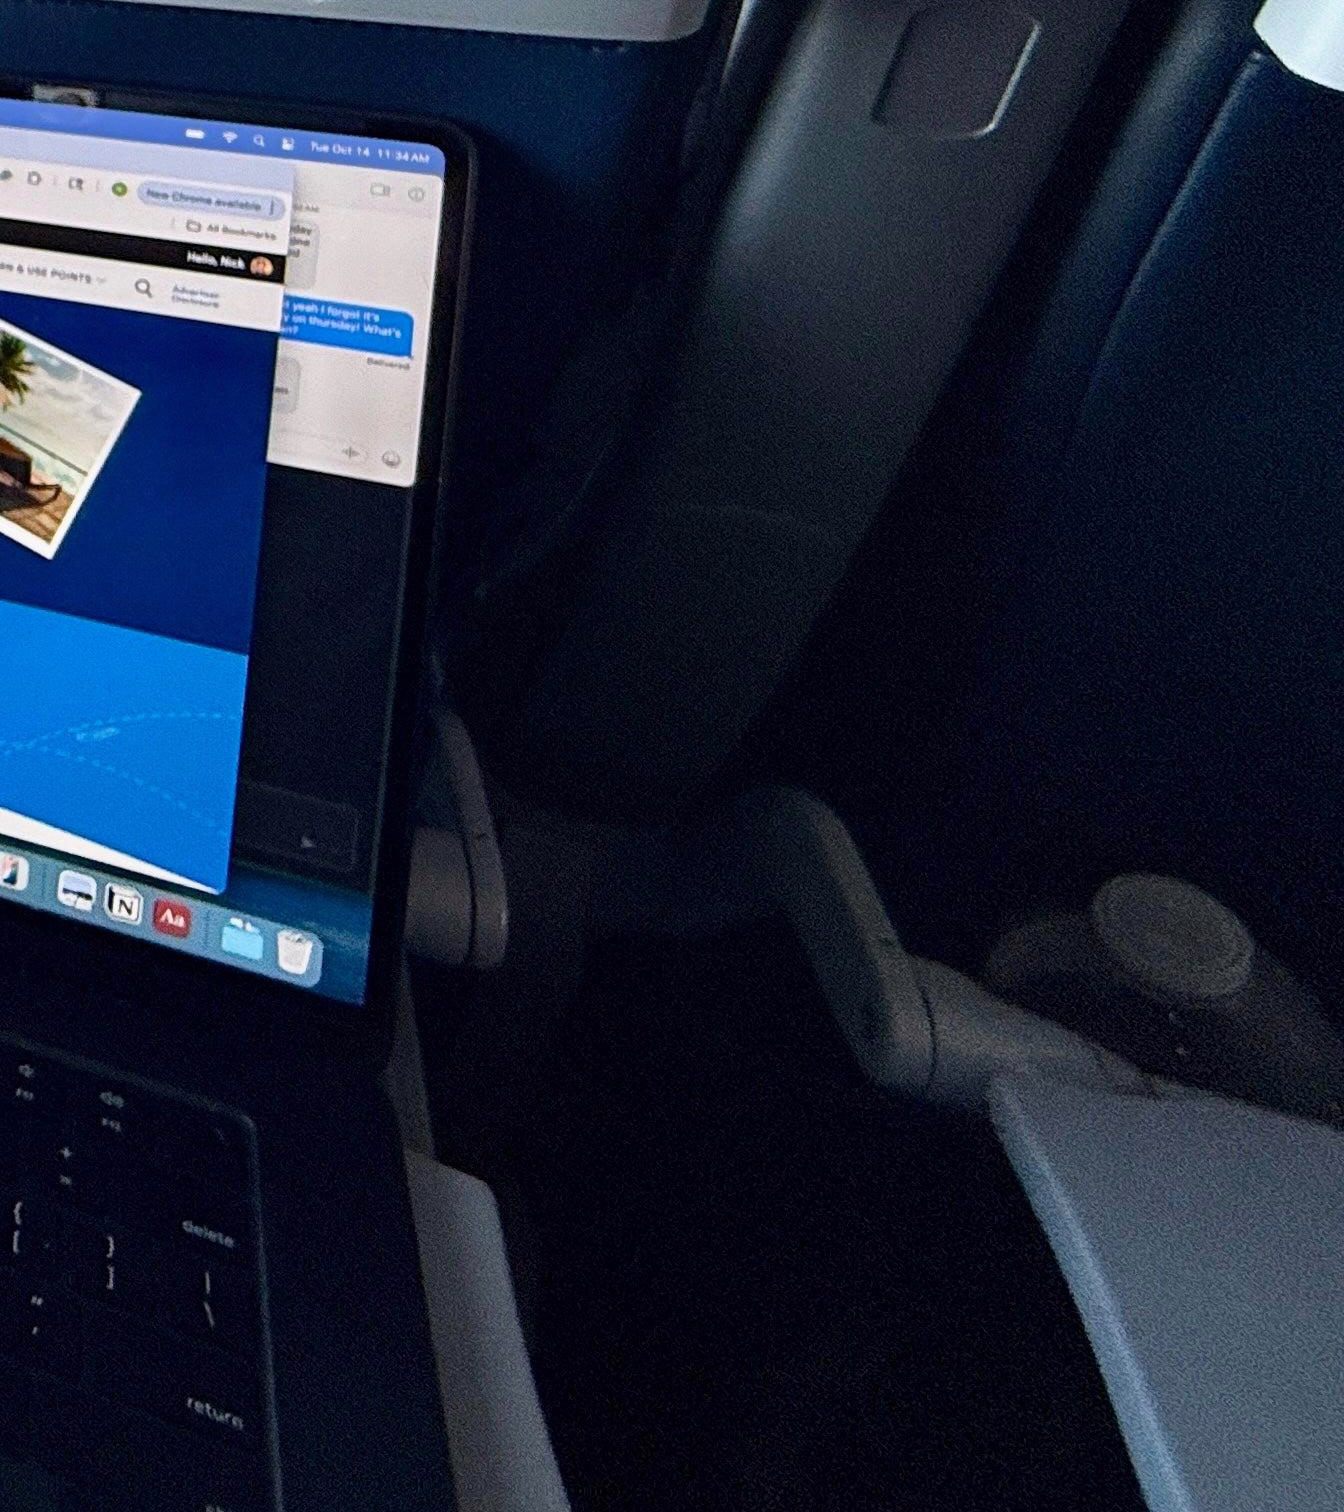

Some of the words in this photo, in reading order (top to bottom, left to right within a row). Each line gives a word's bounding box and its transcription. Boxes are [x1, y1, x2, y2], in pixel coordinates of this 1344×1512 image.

[118, 899, 133, 916] N
[182, 1221, 234, 1247] delete
[187, 1398, 243, 1429] return
